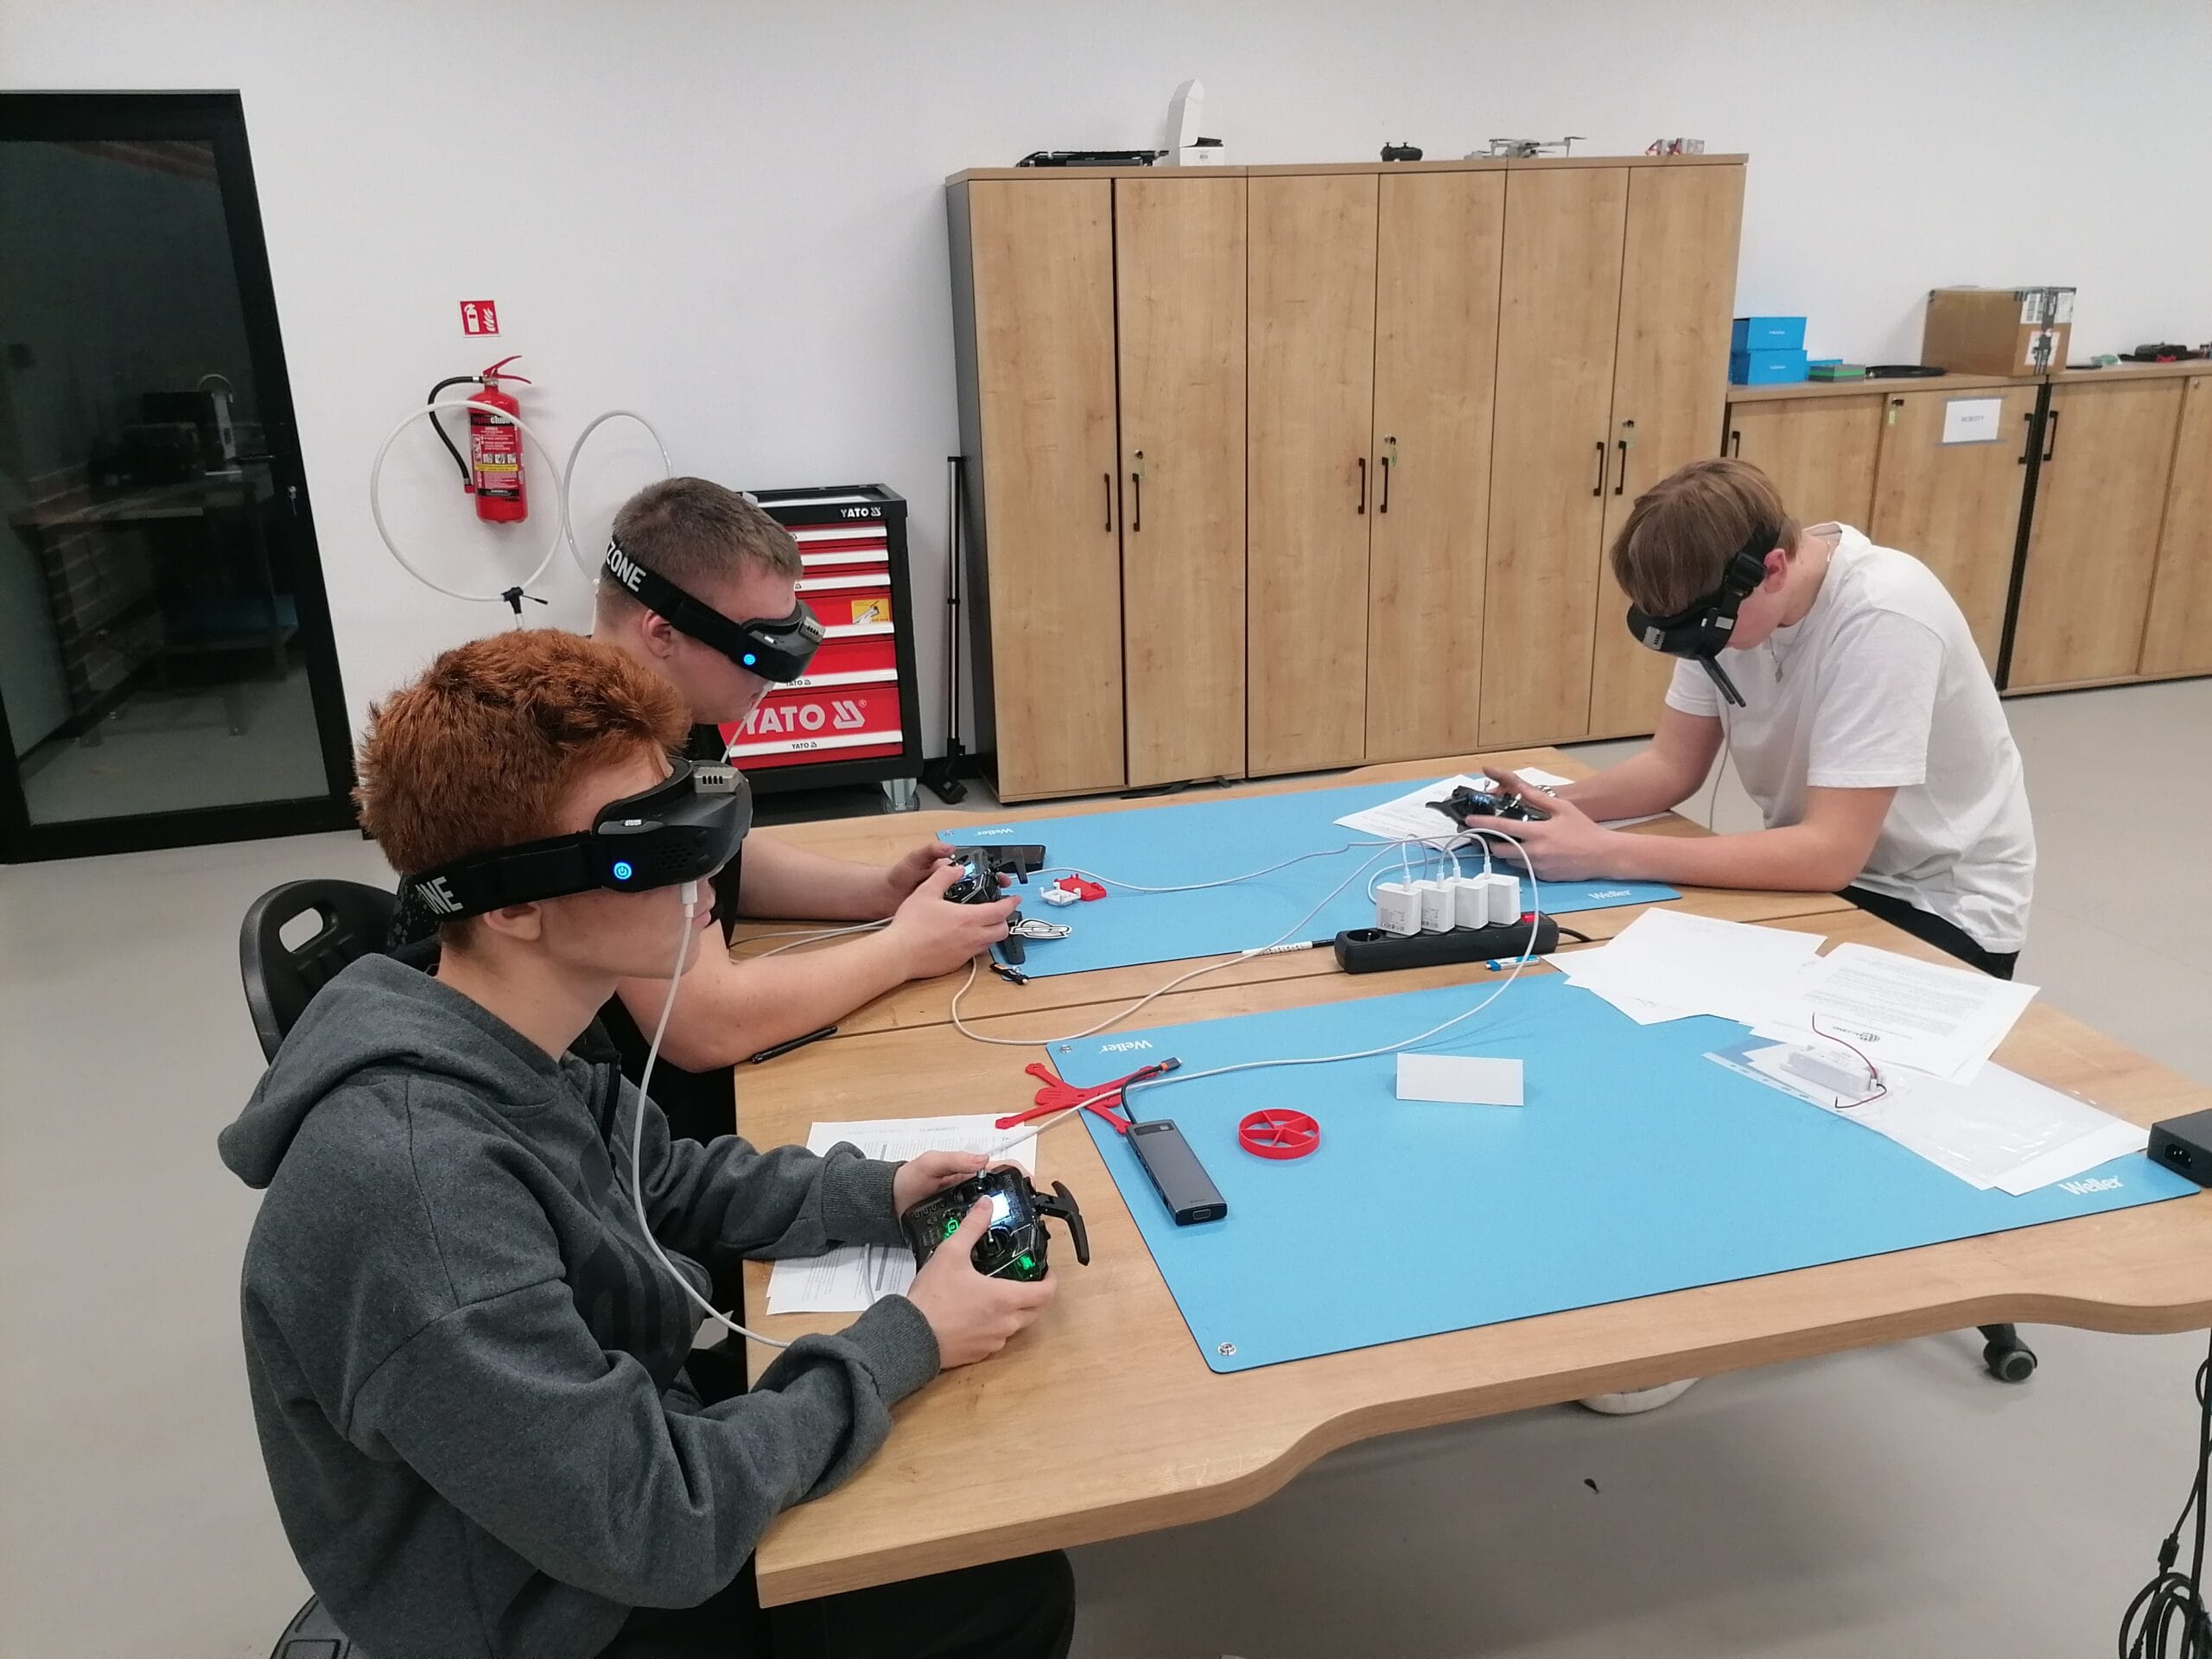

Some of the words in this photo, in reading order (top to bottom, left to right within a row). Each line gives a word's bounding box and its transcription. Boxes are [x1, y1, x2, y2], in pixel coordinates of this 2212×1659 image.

[840, 507, 869, 518] YATO
[607, 540, 647, 593] ZONE
[745, 703, 826, 735] YATO
[1587, 890, 1631, 899] Weller
[1099, 1039, 1154, 1054] Weller
[2057, 1175, 2124, 1195] Weller
